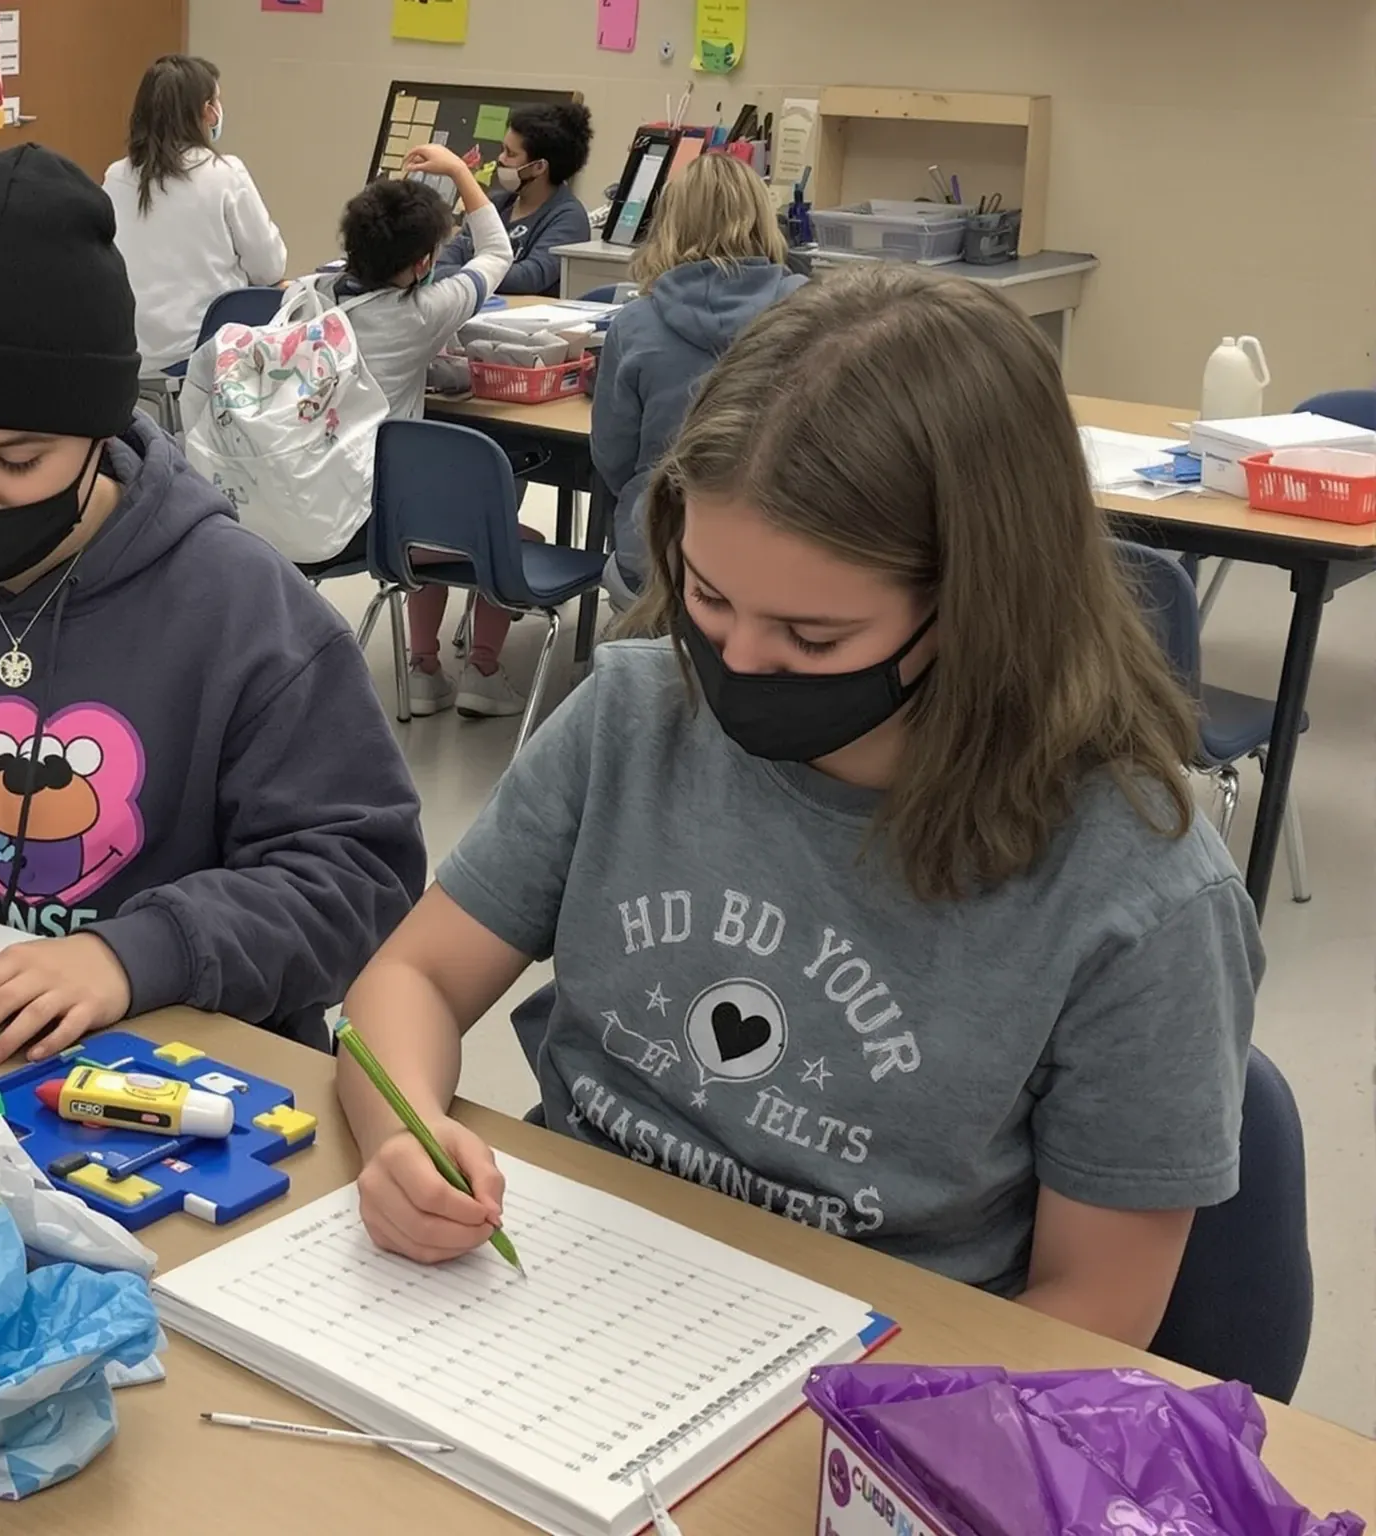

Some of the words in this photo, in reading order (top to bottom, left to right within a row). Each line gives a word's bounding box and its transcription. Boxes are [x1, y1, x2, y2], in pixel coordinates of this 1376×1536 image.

[617, 889, 693, 955] HD
[713, 888, 787, 957] BD
[803, 927, 922, 1084] YOUR
[744, 1088, 873, 1165] IELTS
